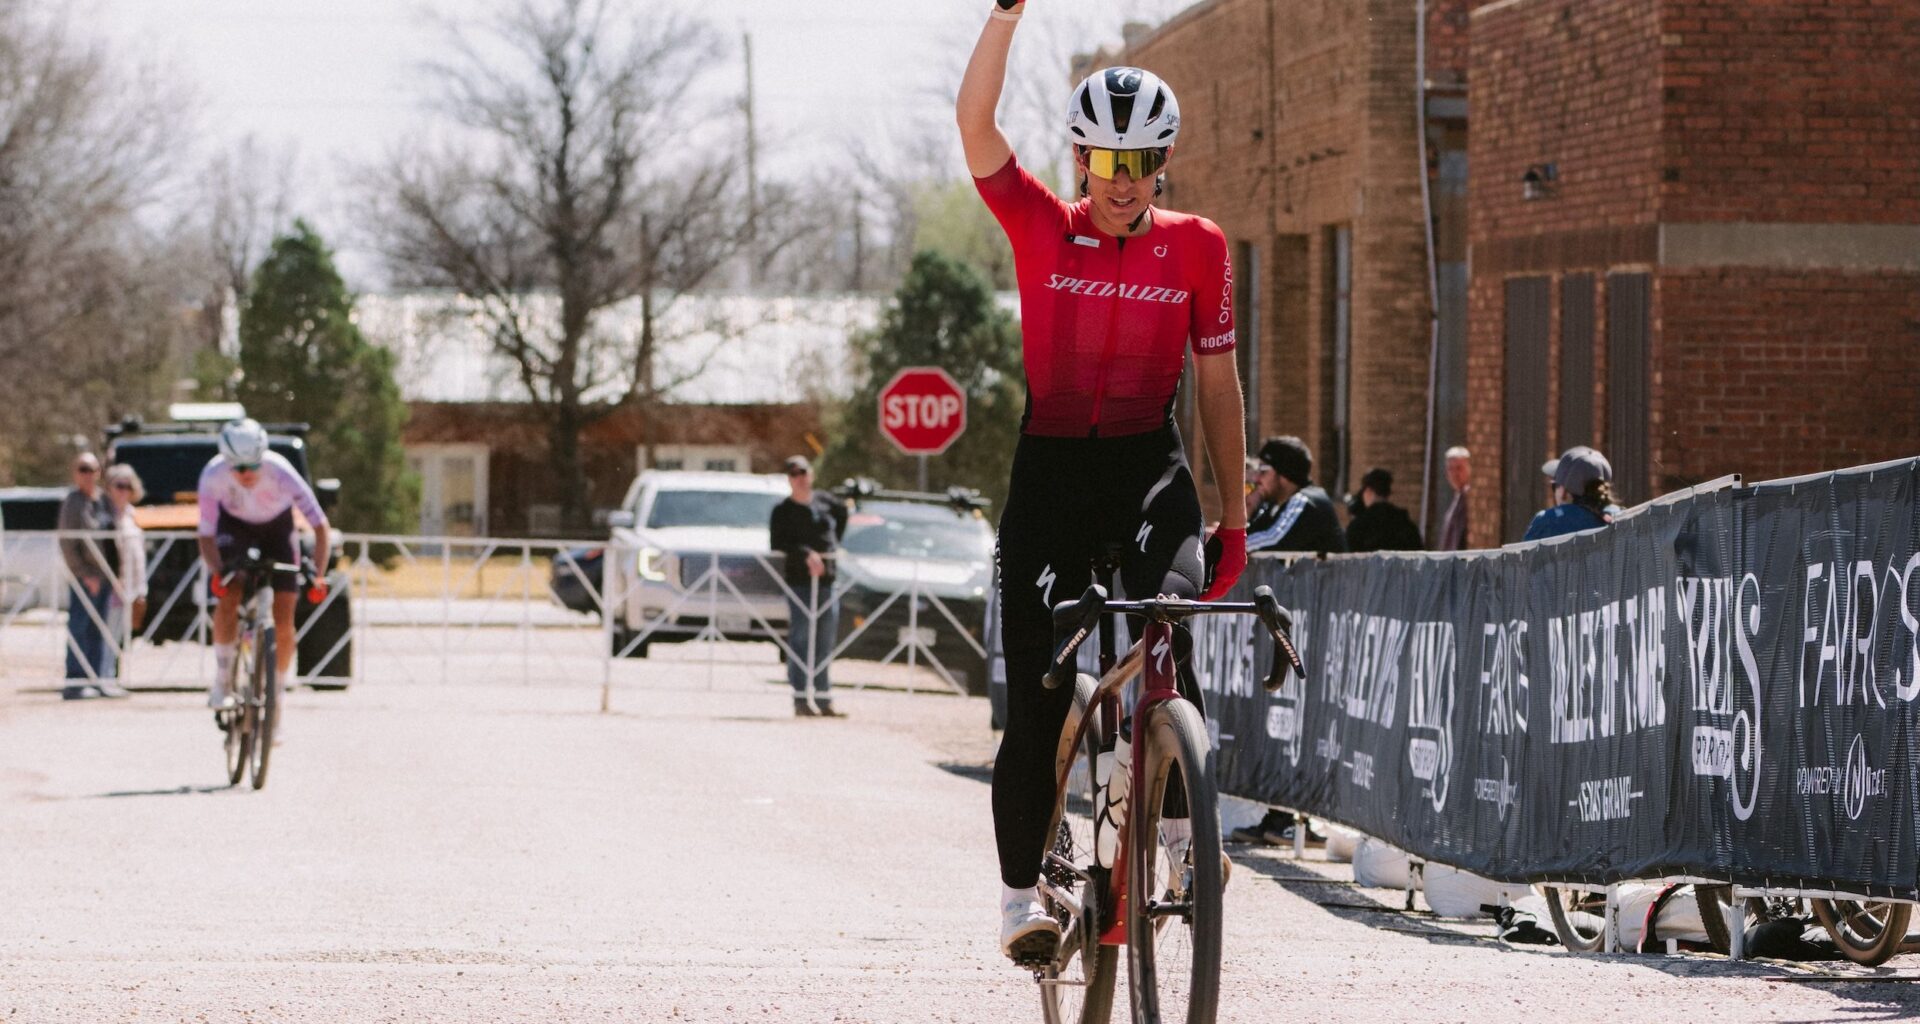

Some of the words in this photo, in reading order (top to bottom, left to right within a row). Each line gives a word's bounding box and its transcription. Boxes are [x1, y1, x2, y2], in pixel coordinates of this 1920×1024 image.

[1044, 273, 1188, 304] SPECIALIZED
[885, 394, 960, 429] STOP
[1056, 627, 1087, 665] SRAM
